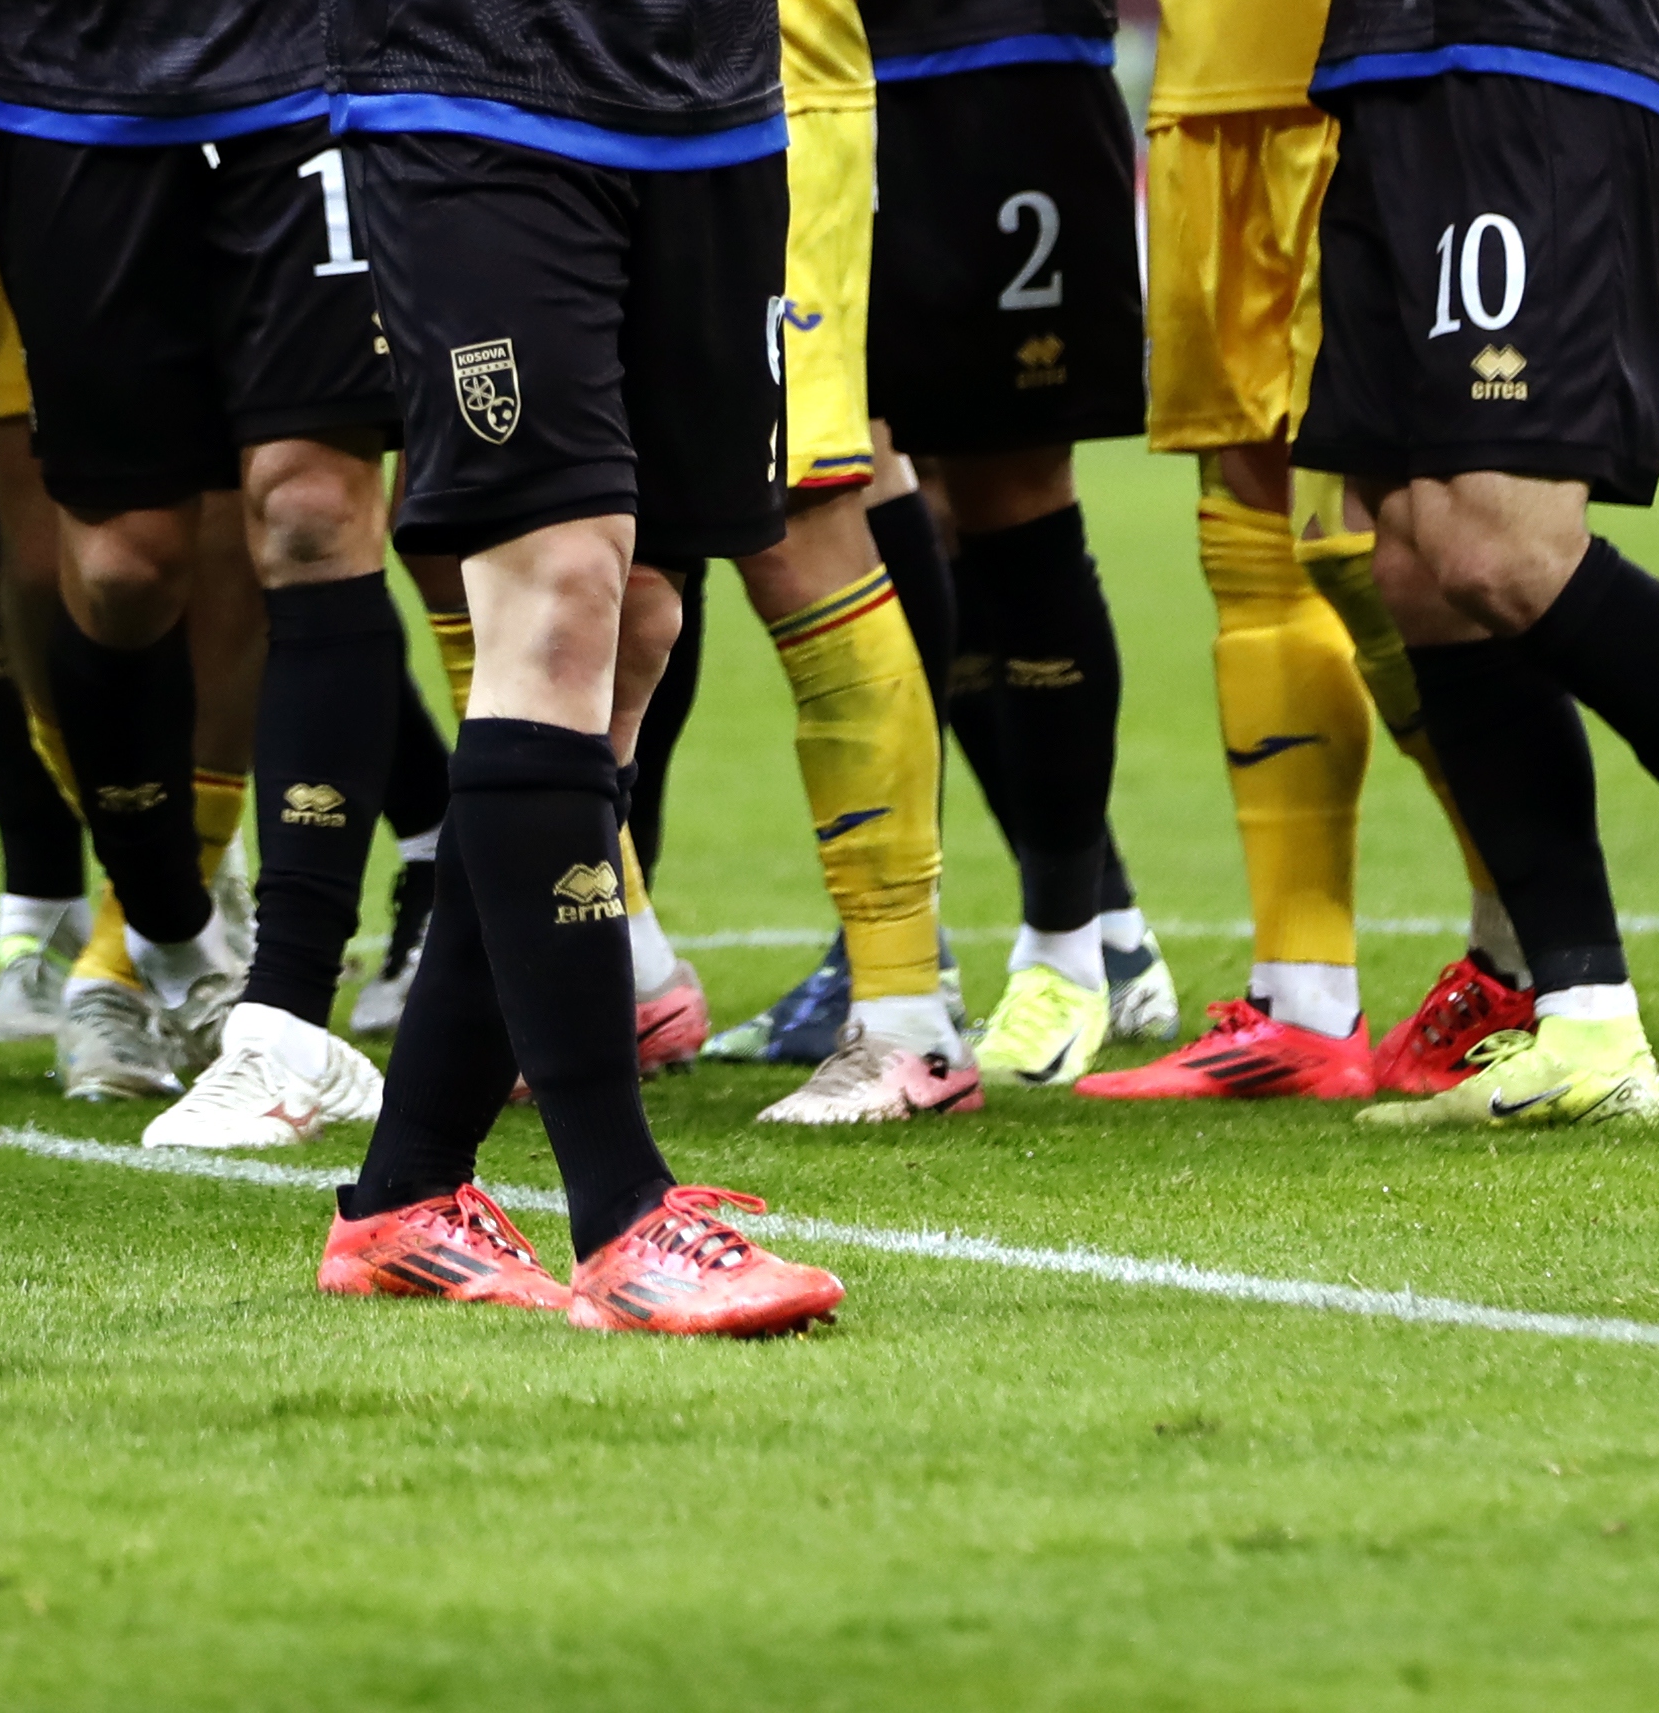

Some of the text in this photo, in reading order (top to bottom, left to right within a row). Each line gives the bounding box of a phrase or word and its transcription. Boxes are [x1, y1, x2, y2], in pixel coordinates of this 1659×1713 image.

[998, 191, 1063, 311] 2
[1428, 213, 1527, 339] 10
[457, 347, 507, 367] KOSOVA
